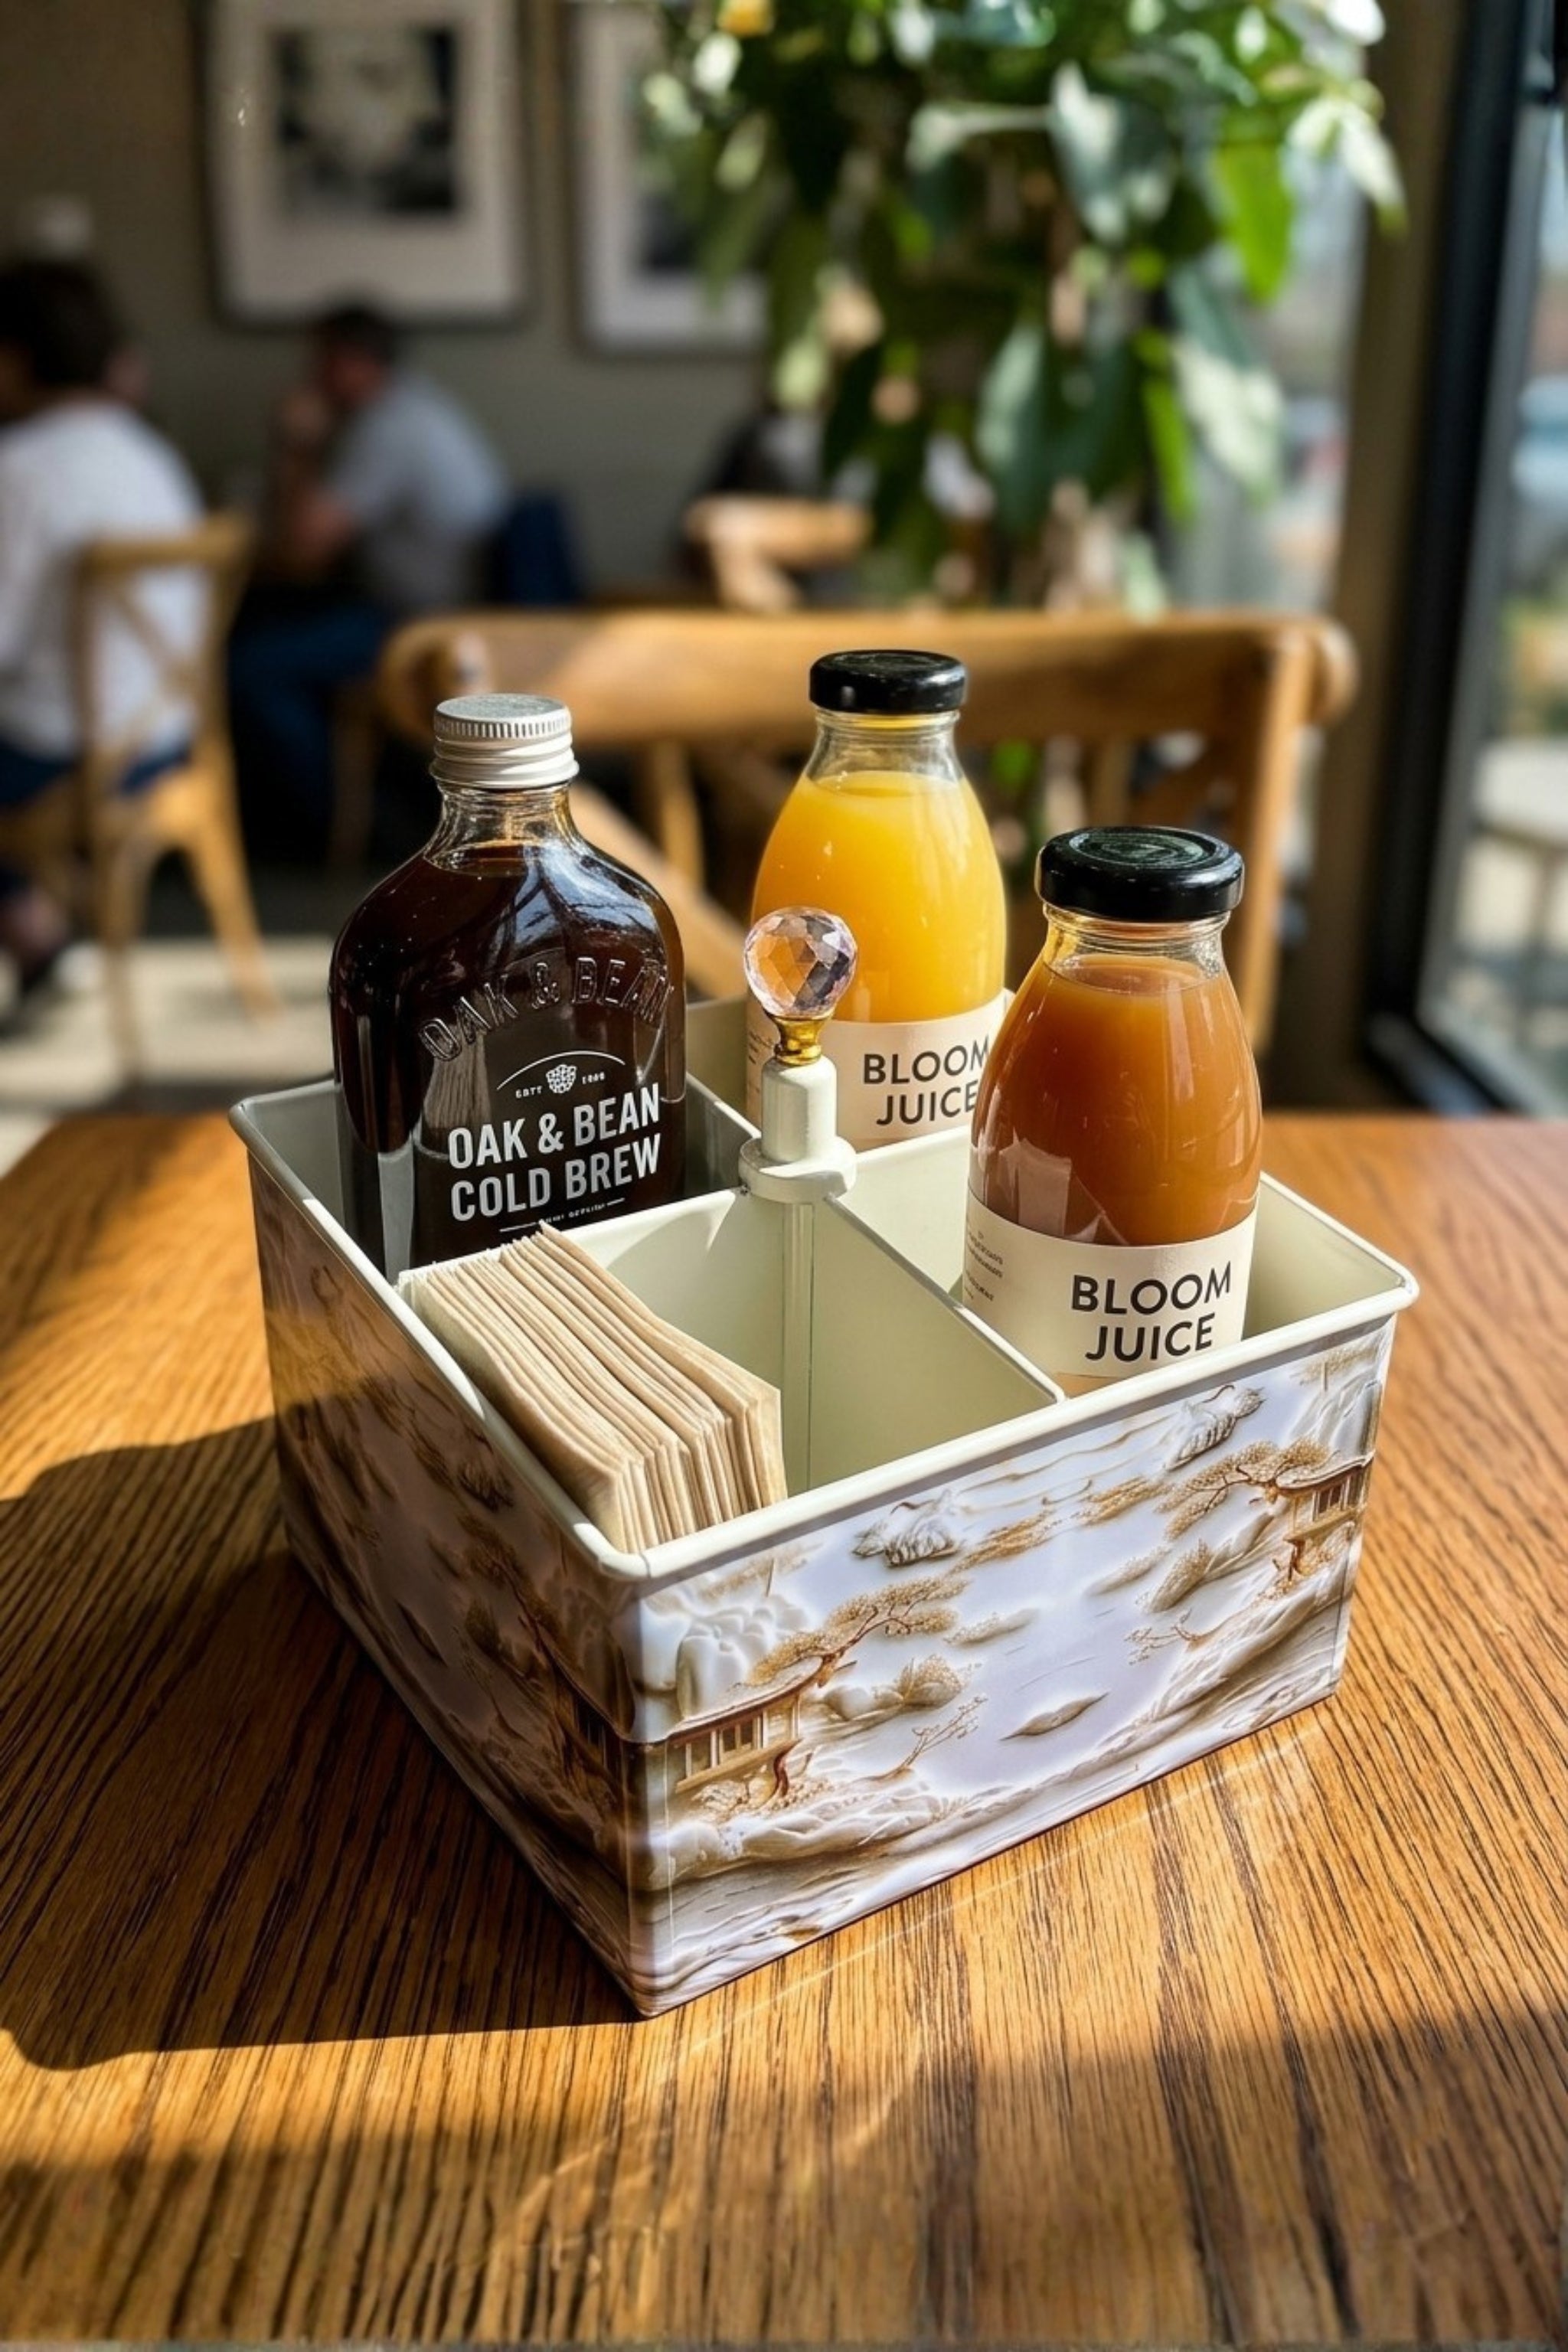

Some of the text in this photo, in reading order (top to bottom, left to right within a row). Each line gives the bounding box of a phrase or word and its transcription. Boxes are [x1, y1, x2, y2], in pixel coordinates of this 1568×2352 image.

[420, 974, 518, 1061] OAK
[531, 962, 560, 1009] &
[864, 1034, 989, 1084] BLOOM
[448, 1082, 659, 1169] OAK & BEAN
[876, 1079, 978, 1125] JUICE
[451, 1132, 662, 1222] COLD BREW
[1071, 1260, 1231, 1316] BLOOM
[1085, 1312, 1216, 1363] JUICE
